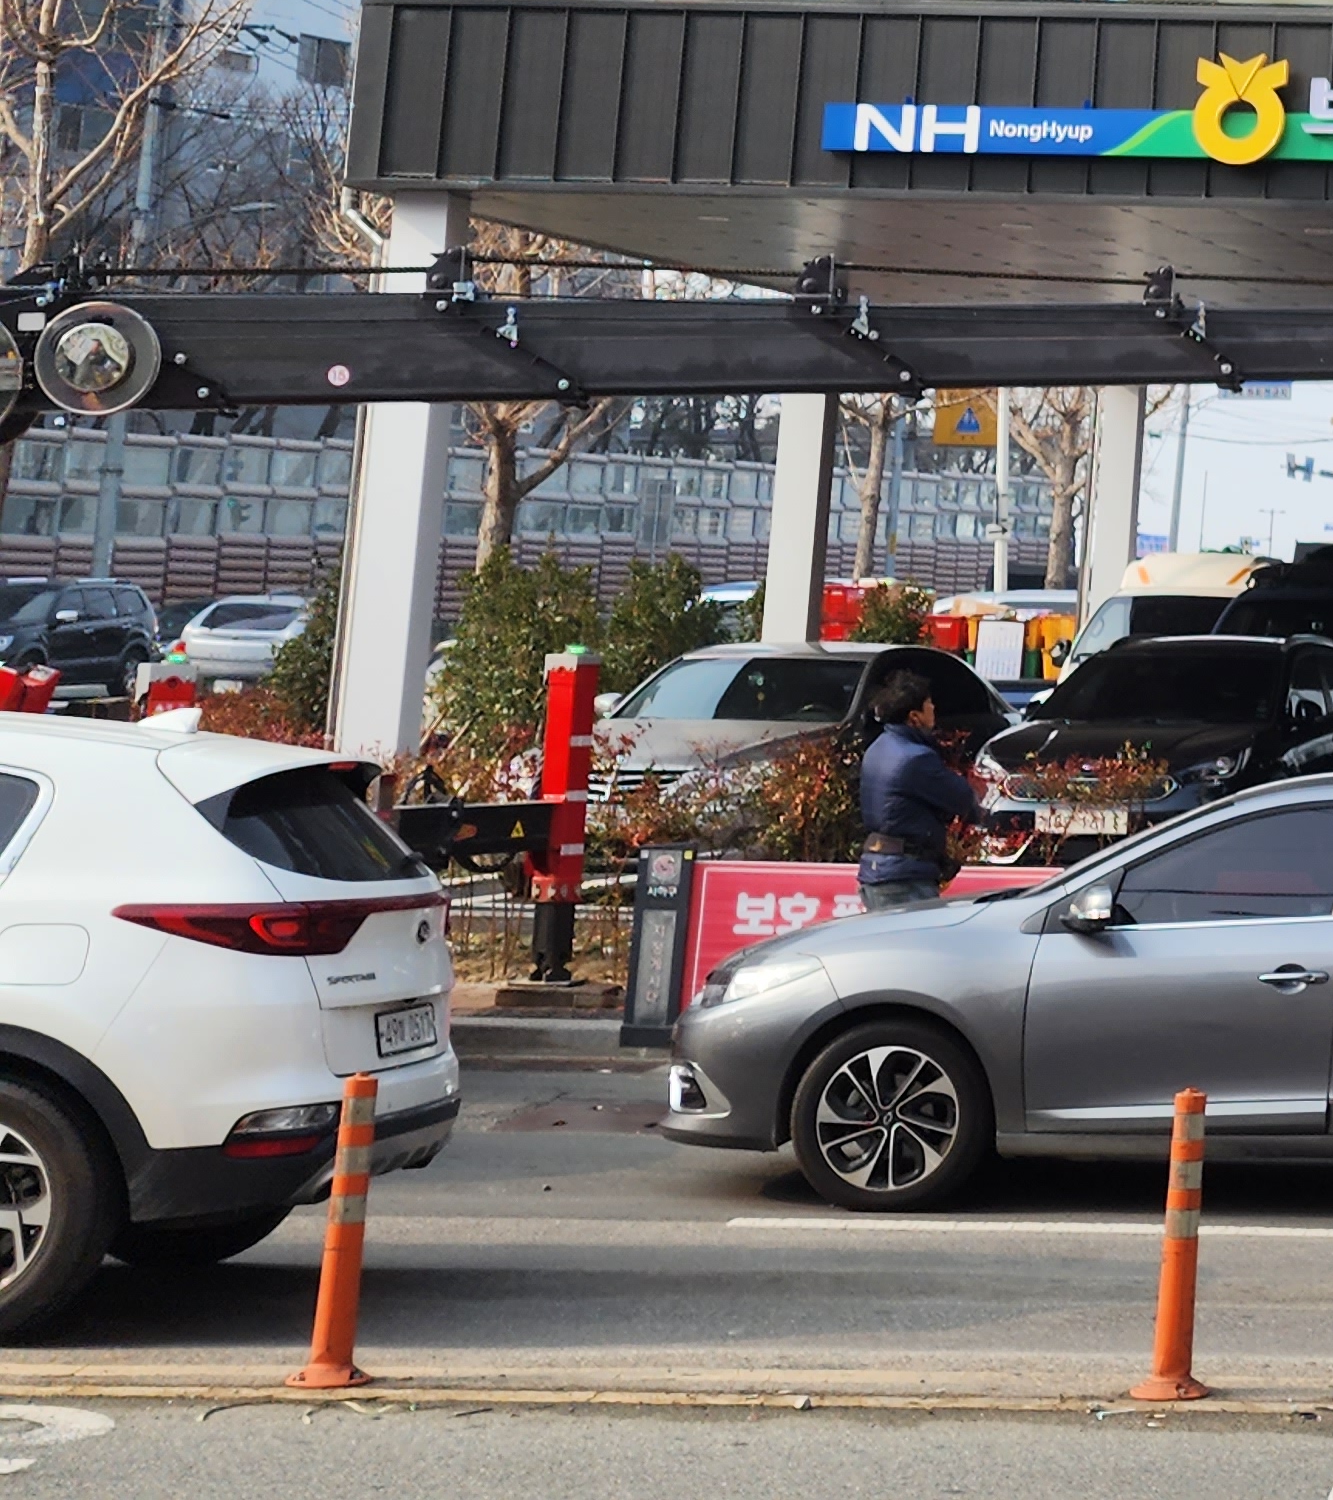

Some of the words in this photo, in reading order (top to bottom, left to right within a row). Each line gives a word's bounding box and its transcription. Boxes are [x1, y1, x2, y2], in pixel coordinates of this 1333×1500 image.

[853, 102, 981, 154] NH
[989, 118, 1094, 143] NongHyup
[732, 891, 820, 936] 보호
